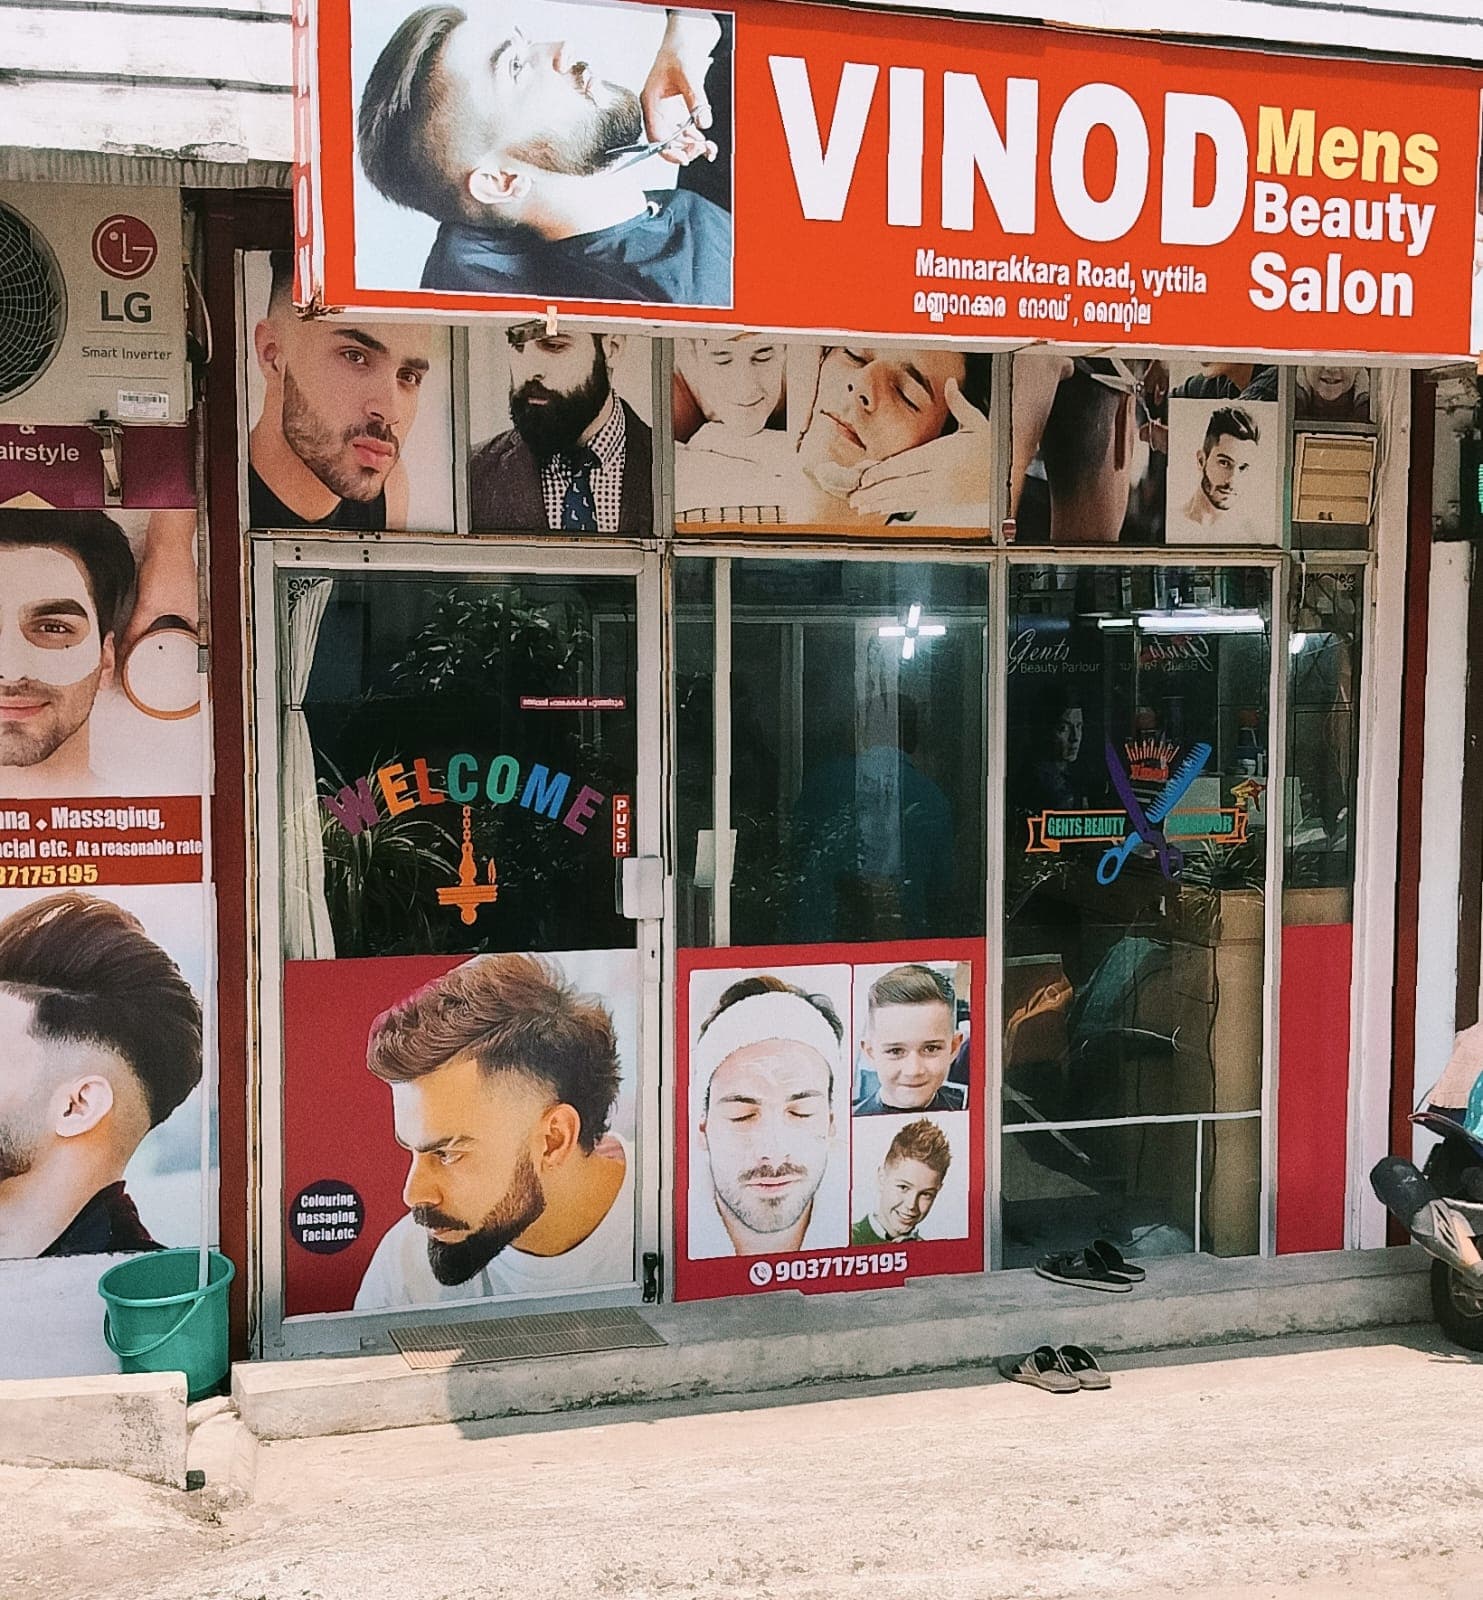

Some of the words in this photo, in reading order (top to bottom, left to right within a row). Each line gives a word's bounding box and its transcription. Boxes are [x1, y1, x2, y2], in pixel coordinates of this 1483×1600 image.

[768, 55, 1248, 247] VINOD
[1256, 105, 1439, 186] Mens
[1253, 180, 1436, 257] Beauty
[915, 249, 1070, 286] Mannarakkara
[1076, 259, 1136, 294] Road,
[1142, 265, 1207, 297] vyttila
[1248, 251, 1413, 317] Salon
[100, 290, 152, 324] LG
[82, 346, 118, 359] Smart
[122, 347, 172, 361] Inverter
[322, 752, 606, 836] WELCOME
[51, 806, 166, 831] Massaging,
[615, 799, 628, 853] PUSH
[1047, 817, 1083, 836] GENTS
[1084, 816, 1126, 835] BEAUTY
[0, 838, 37, 858] cial
[39, 839, 73, 858] etc.
[76, 840, 90, 857] At
[91, 842, 101, 857] a
[101, 839, 174, 857] reasonable
[775, 1252, 908, 1282] 9037175195
